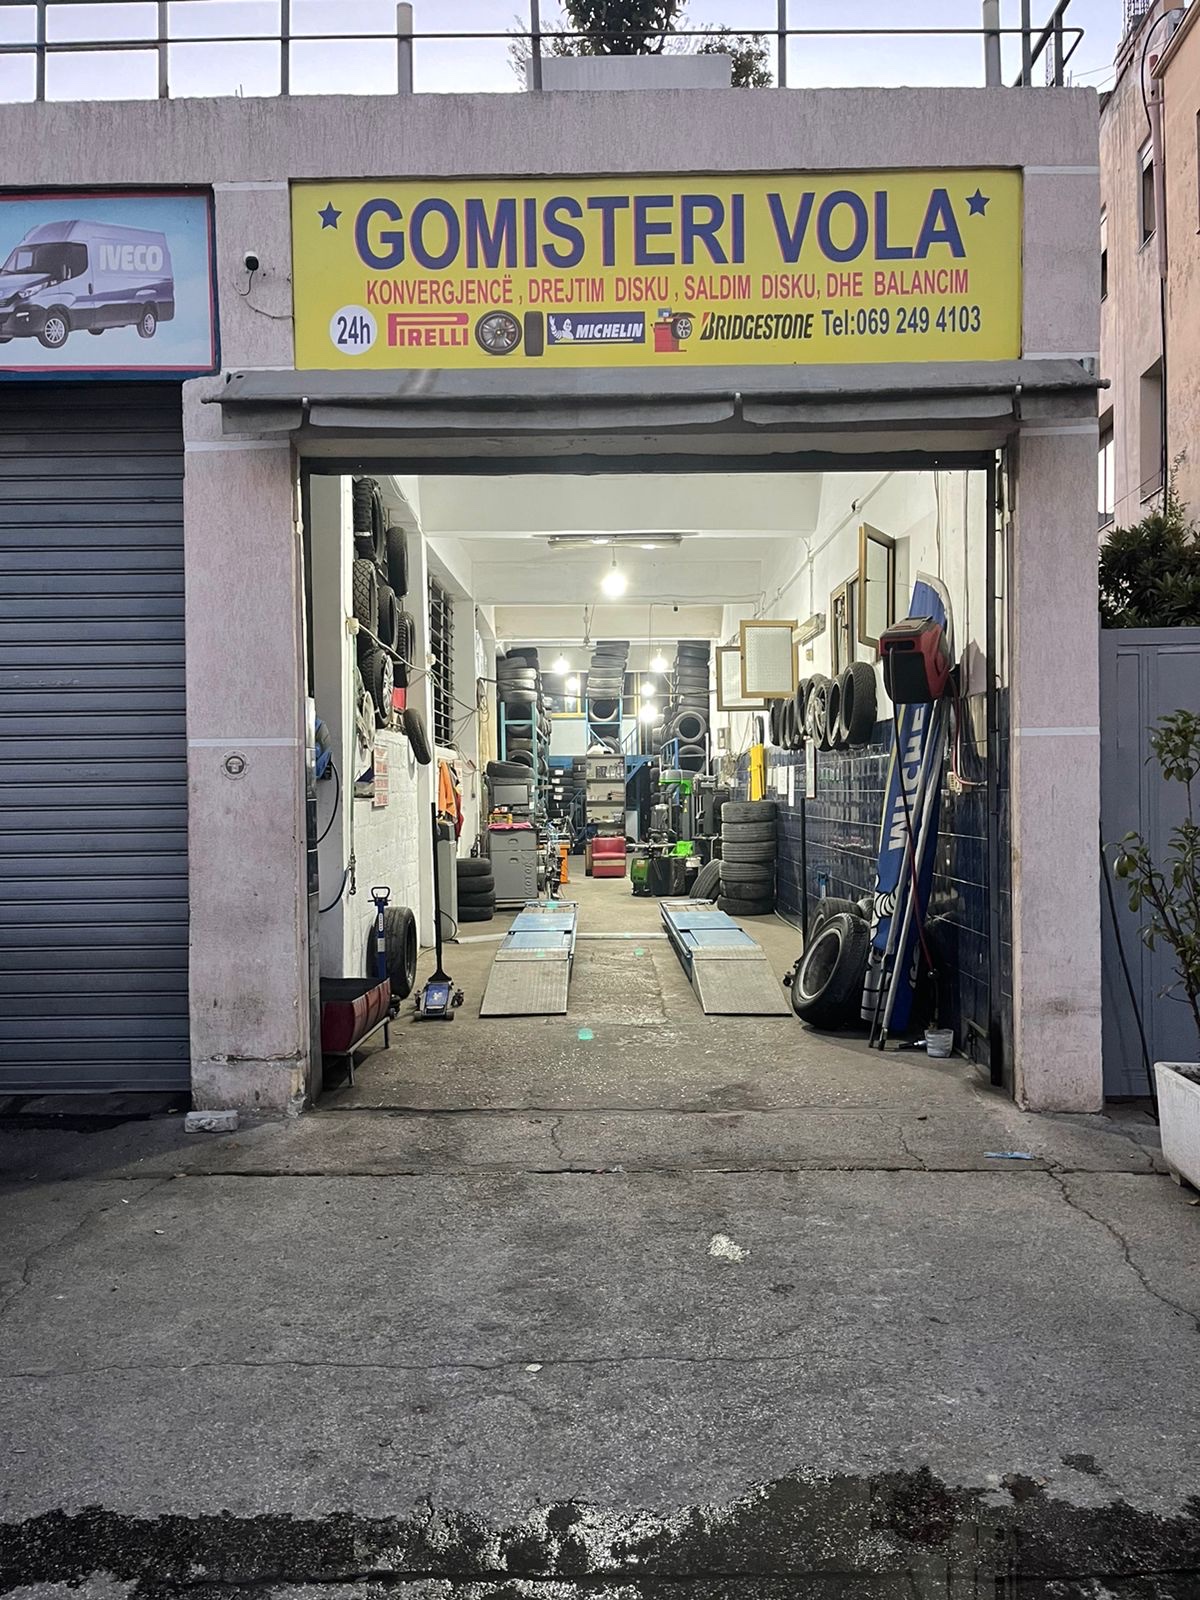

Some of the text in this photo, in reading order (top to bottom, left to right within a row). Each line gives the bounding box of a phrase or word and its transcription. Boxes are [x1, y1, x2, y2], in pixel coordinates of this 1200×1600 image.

[354, 188, 966, 270] GOMISTERI VOLA
[99, 244, 163, 272] IVECO
[528, 278, 604, 303] DREJTIM
[685, 275, 751, 300] SALDIM
[761, 273, 821, 300] DISKU,
[826, 272, 863, 298] DHE
[874, 268, 969, 296] BALANCIM
[337, 316, 371, 345] 24h
[387, 312, 469, 347] PIRELLI
[576, 322, 643, 339] MICHELIN
[700, 312, 814, 341] BRIDGESTONE
[896, 307, 930, 334] 249
[935, 305, 981, 333] 4103
